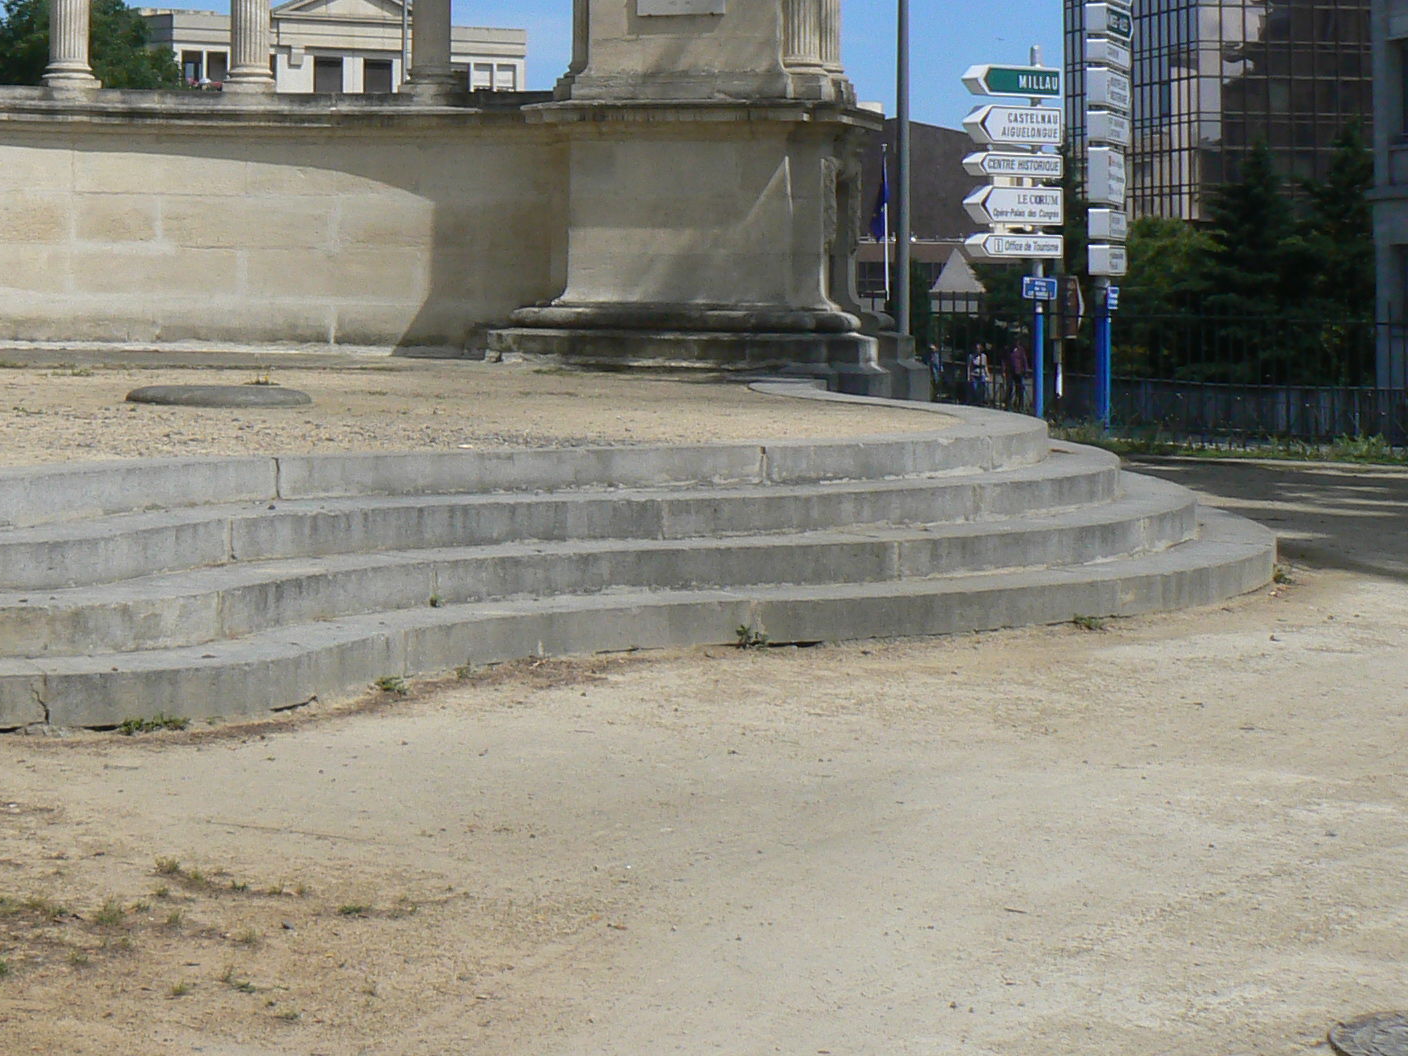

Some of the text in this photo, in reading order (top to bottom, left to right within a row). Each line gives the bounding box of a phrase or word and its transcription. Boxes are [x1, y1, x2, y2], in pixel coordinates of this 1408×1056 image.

[1018, 74, 1058, 90] MILLAU
[1007, 112, 1058, 125] CASTELNAU
[1001, 126, 1058, 139] AIGUELONGUE
[987, 158, 1059, 172] CENTRE HISTORIQUE
[1017, 194, 1029, 205] LE
[1005, 240, 1022, 251] Office
[1024, 240, 1032, 251] de
[1033, 240, 1059, 252] Tourisme
